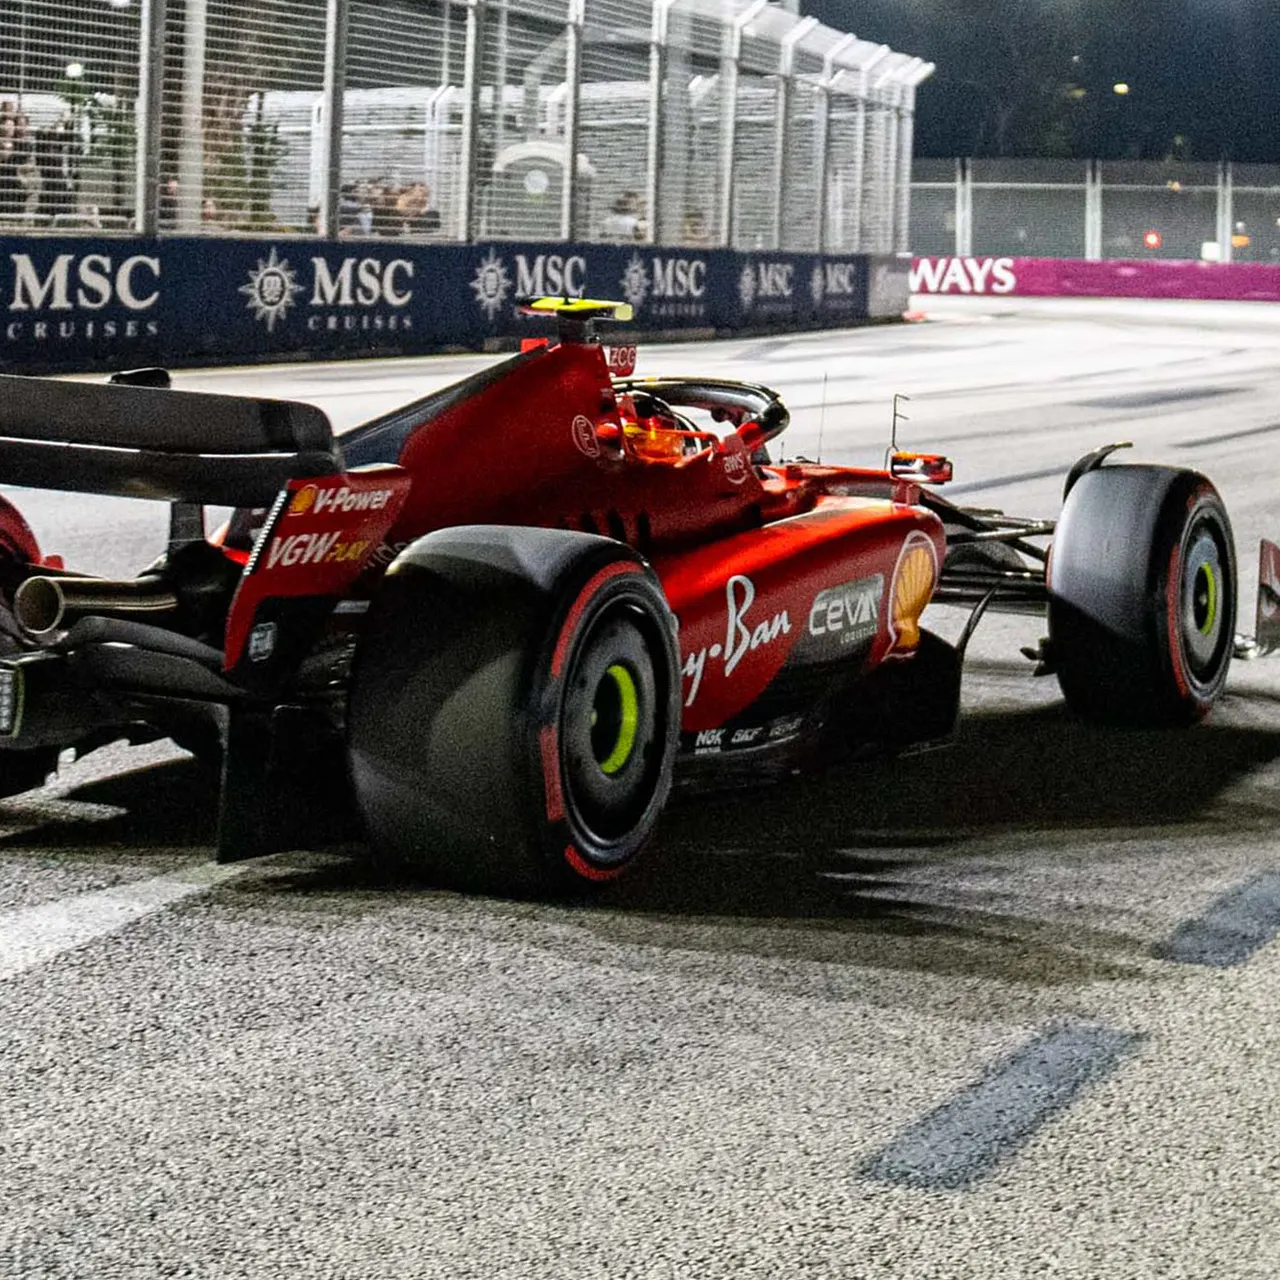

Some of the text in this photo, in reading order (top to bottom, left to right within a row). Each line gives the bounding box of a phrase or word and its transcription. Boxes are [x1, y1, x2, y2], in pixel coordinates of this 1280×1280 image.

[8, 253, 162, 310] MSC
[309, 256, 414, 306] MSC
[515, 255, 587, 298] MSC
[651, 258, 707, 297] MSC
[6, 320, 160, 340] CRUISES
[313, 486, 392, 514] V-Power
[695, 727, 726, 748] NGK
